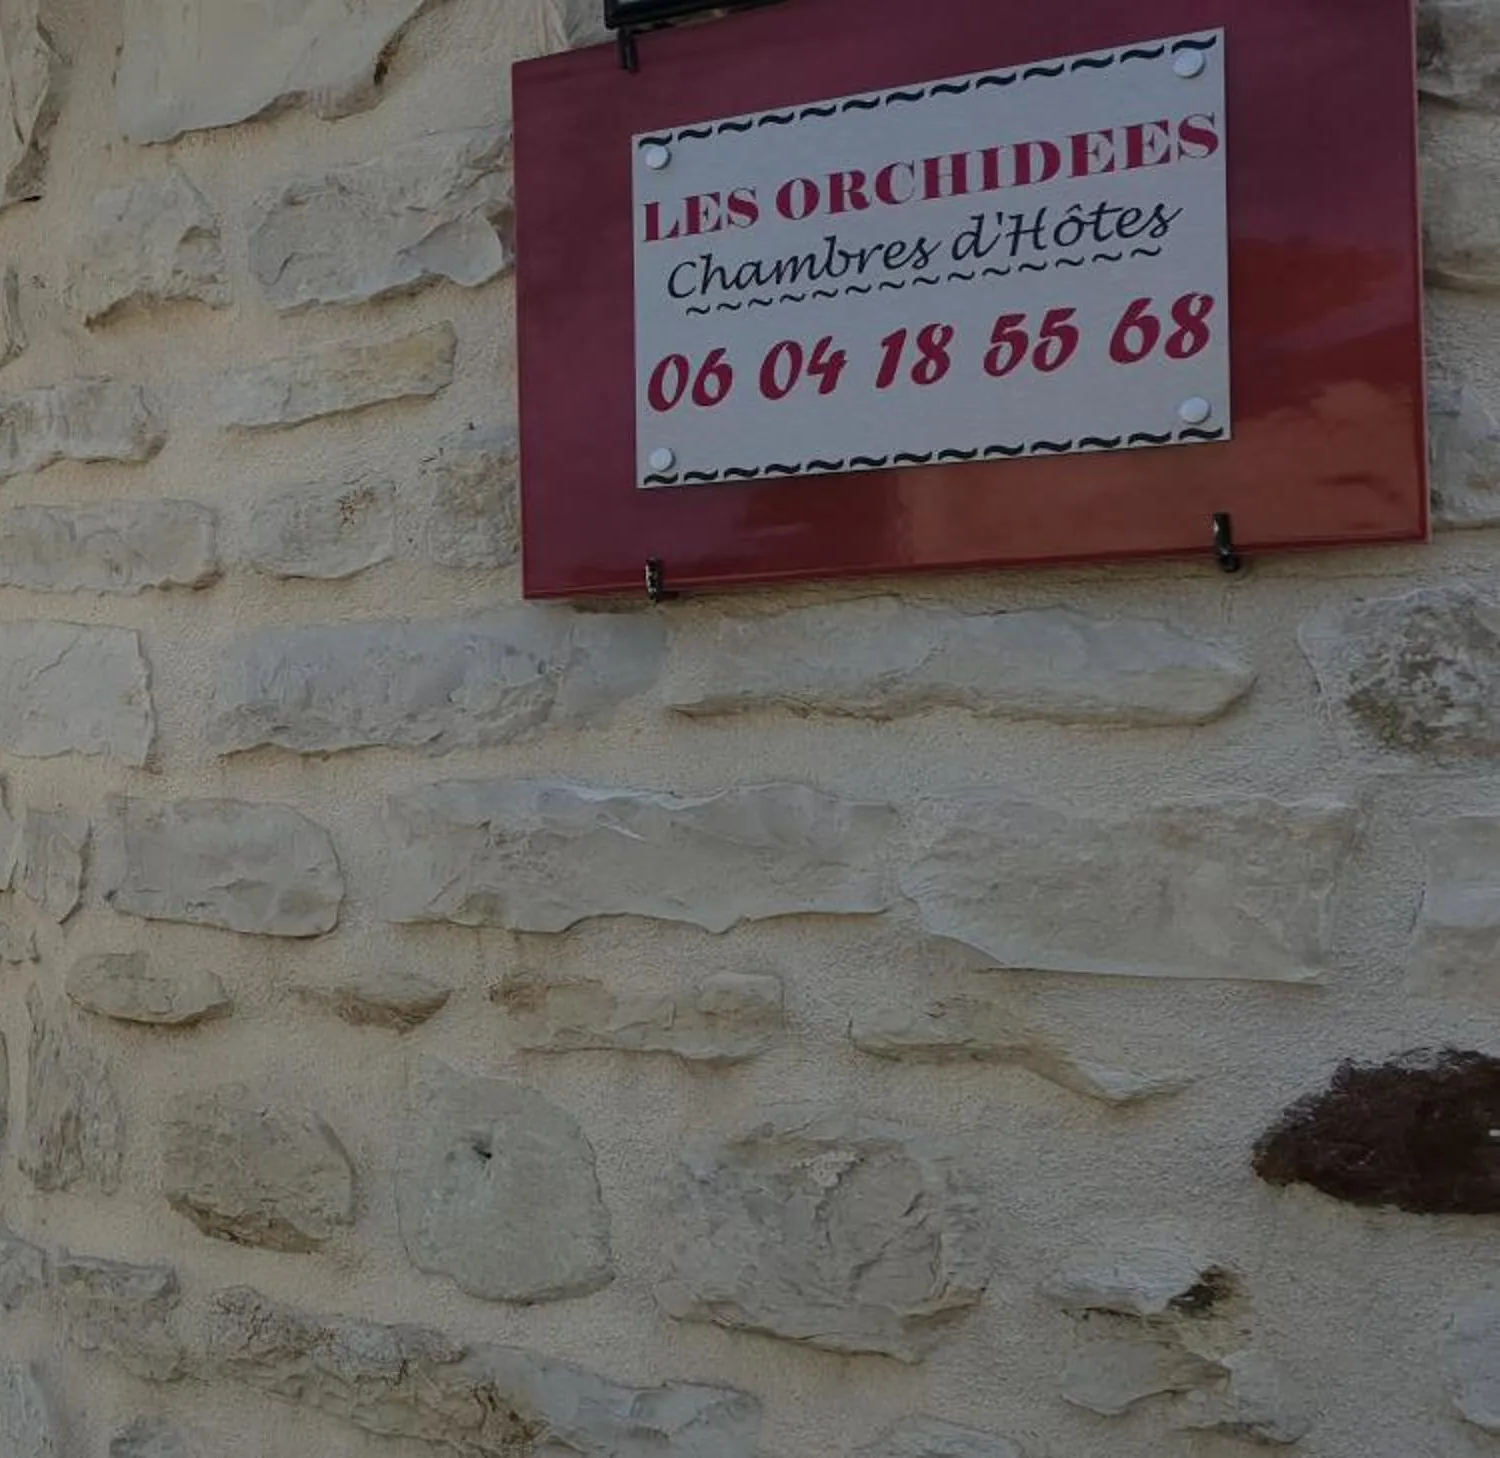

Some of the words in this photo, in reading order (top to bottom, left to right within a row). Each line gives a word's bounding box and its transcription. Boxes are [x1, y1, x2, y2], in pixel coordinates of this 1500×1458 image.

[642, 187, 760, 243] LES
[775, 112, 1220, 221] ORCHIDEES
[667, 235, 941, 300] Chambres
[951, 201, 1184, 261] d'Hôtes
[647, 347, 734, 412] 06
[758, 335, 848, 400] 04
[874, 322, 955, 389] 18
[982, 307, 1080, 377] 55
[1108, 291, 1216, 365] 68
